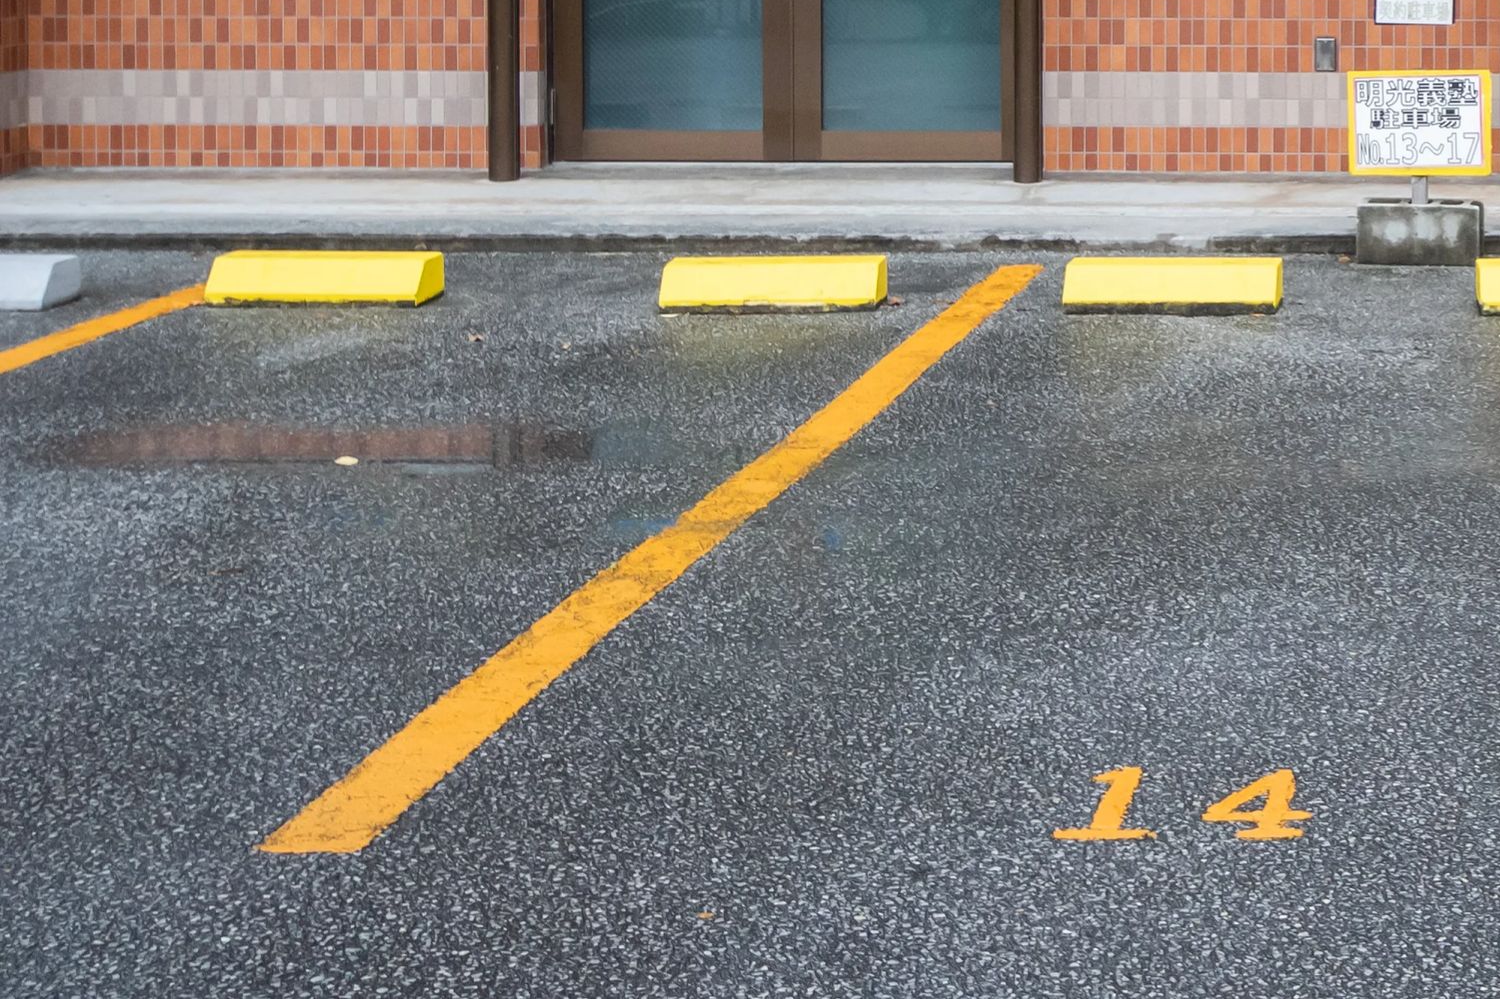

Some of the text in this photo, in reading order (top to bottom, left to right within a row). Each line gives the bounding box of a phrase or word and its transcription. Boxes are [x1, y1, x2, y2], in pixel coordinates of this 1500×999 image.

[1355, 78, 1478, 107] 明光義塾
[1370, 107, 1461, 129] 駐車場
[1052, 766, 1312, 840] 14
